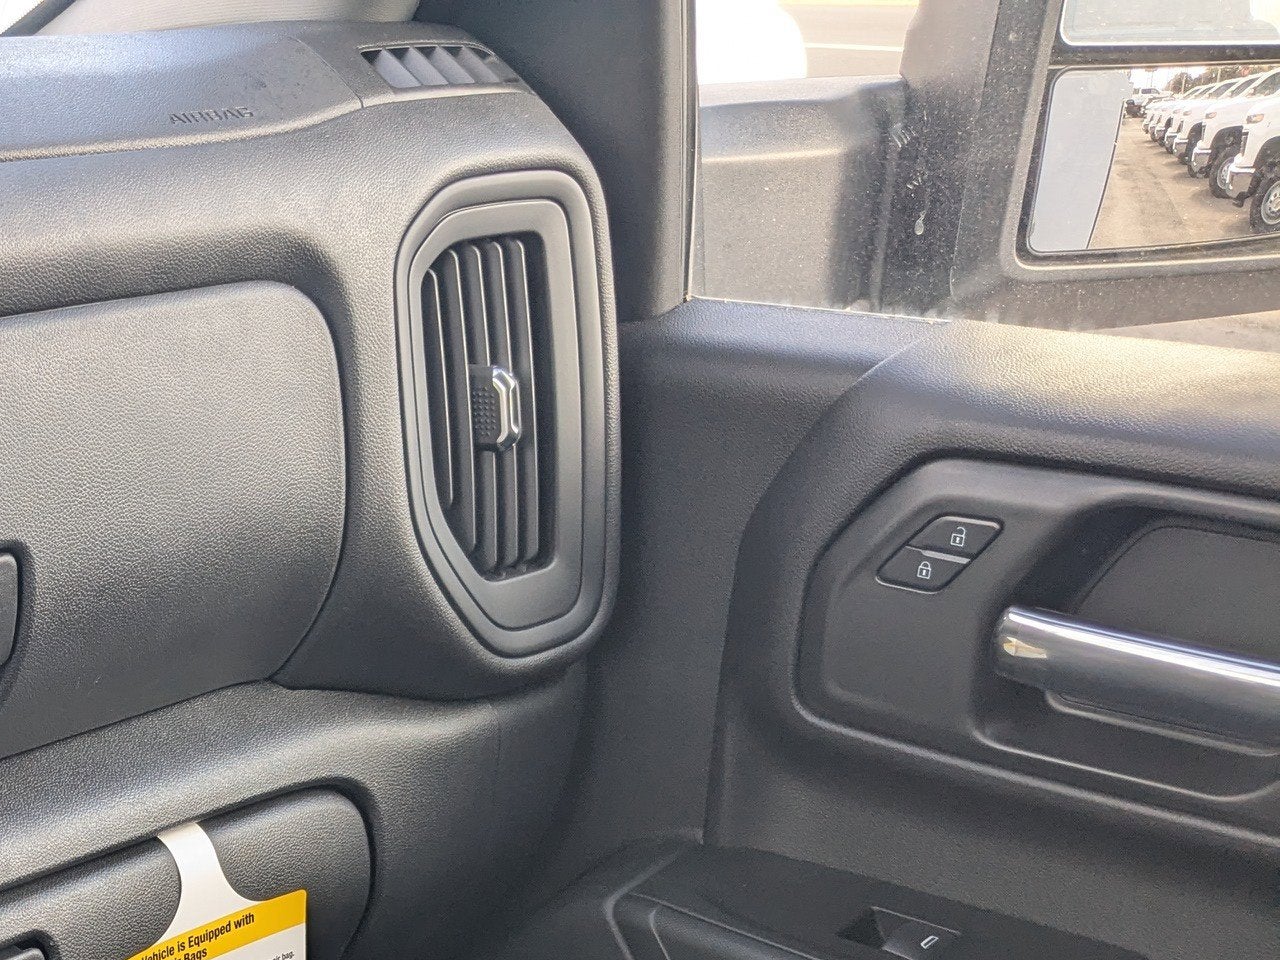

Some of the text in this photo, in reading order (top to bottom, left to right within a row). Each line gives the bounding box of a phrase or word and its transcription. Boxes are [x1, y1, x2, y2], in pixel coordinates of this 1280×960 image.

[169, 107, 254, 124] AIRBAG
[177, 941, 186, 952] is
[188, 921, 232, 948] Equipped
[234, 912, 255, 930] with
[282, 951, 295, 960] bag.
